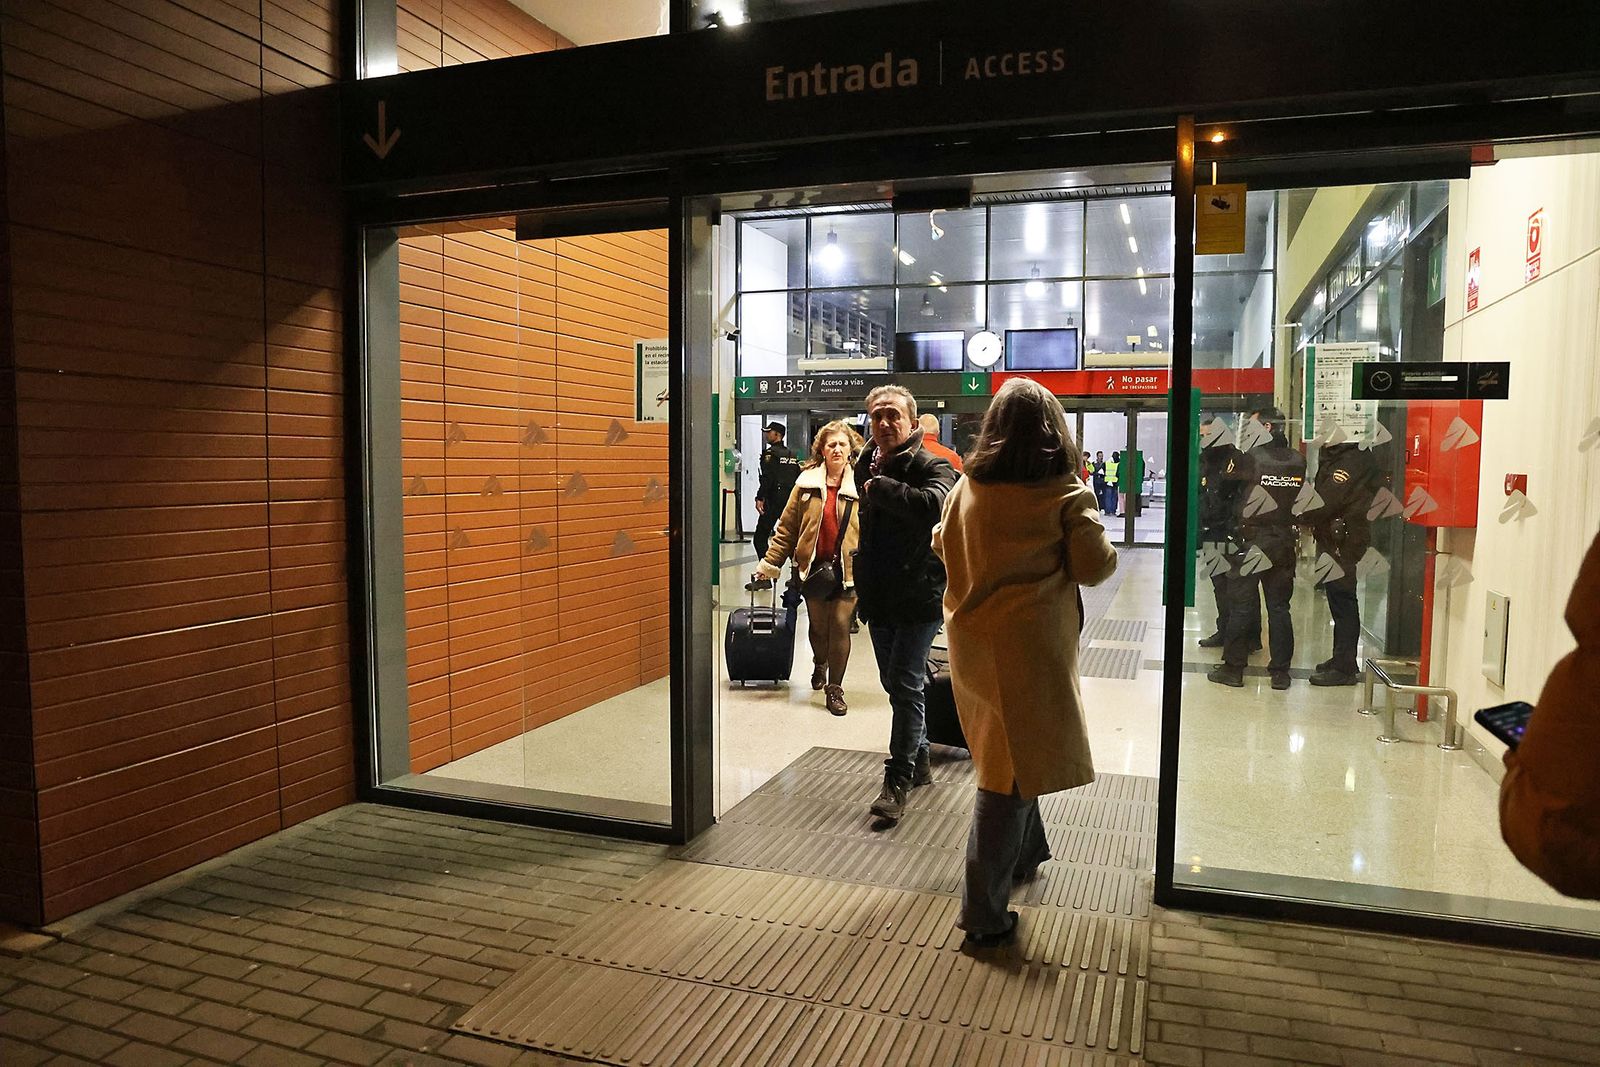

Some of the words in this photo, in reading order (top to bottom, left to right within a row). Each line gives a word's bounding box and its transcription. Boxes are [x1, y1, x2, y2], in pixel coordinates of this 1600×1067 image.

[766, 52, 919, 101] Entrada
[965, 48, 1066, 81] ACCESS
[1135, 376, 1158, 384] pasar
